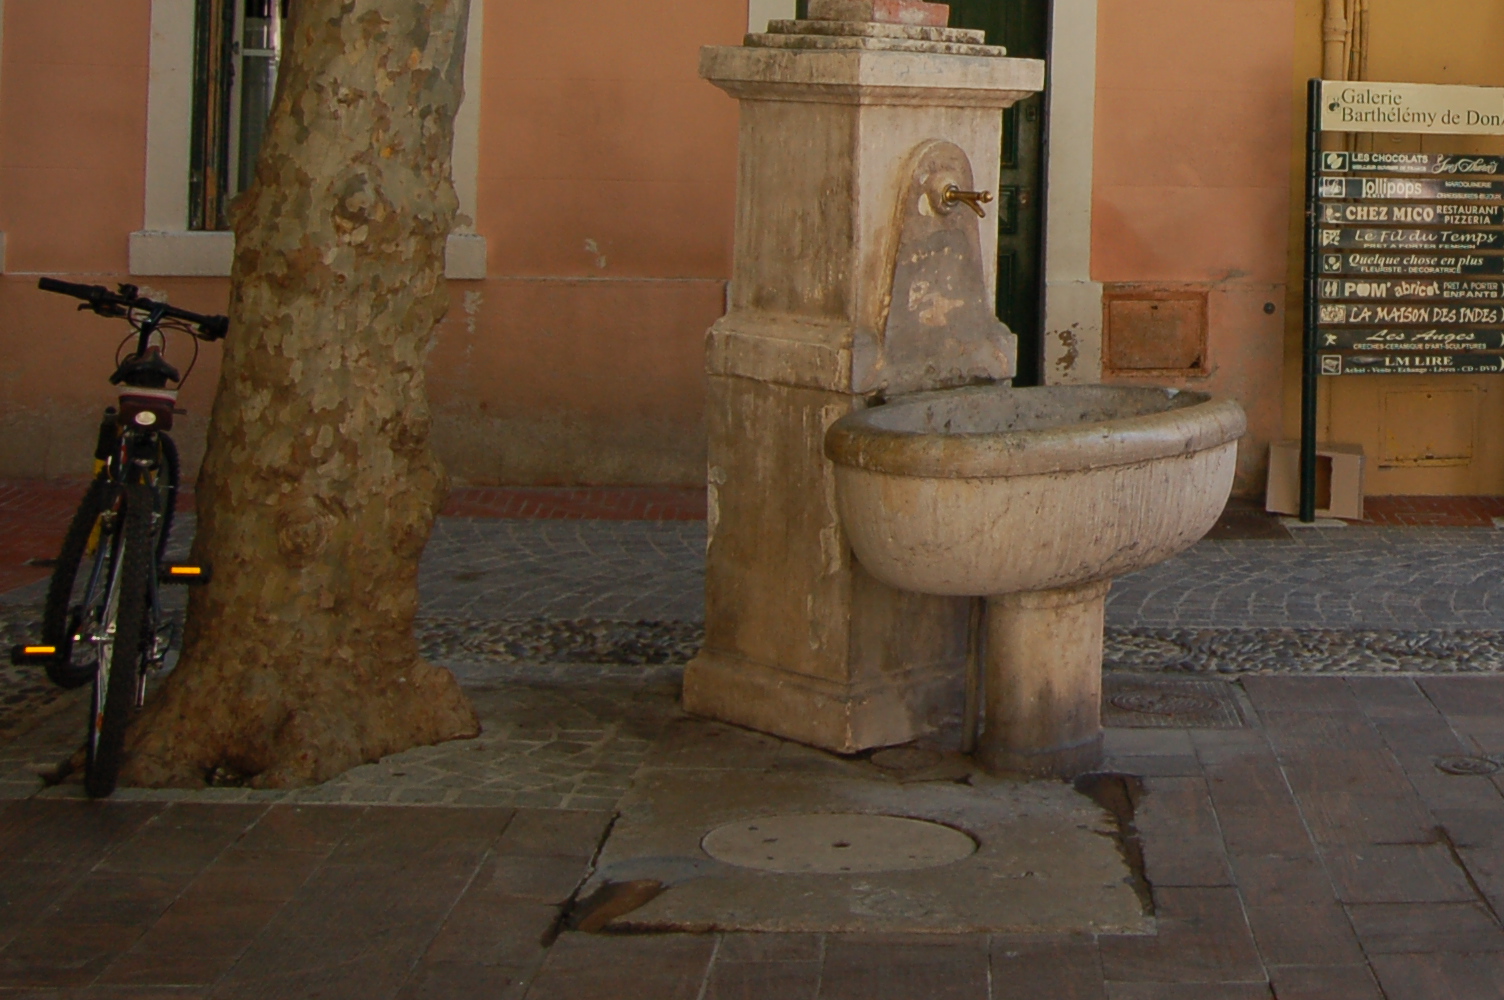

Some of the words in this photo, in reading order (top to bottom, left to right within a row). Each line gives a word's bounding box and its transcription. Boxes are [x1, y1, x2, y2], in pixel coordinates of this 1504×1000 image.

[1341, 87, 1403, 106] Galerie
[1342, 106, 1438, 128] Barthélémy
[1441, 109, 1460, 125] de
[1467, 109, 1500, 127] Don
[1352, 153, 1369, 163] LES
[1371, 154, 1429, 164] CHOCOLATS
[1345, 206, 1388, 221] CHEZ
[1393, 206, 1434, 222] MICO
[1436, 205, 1499, 215] RESTAURANT
[1444, 214, 1491, 224] PIZZERIA
[1355, 230, 1377, 242] Le
[1380, 230, 1406, 242] Fil
[1409, 230, 1438, 242] du
[1440, 230, 1498, 246] Temps
[1349, 253, 1401, 269] Quelque
[1403, 254, 1441, 266] chose
[1441, 257, 1456, 266] en
[1456, 255, 1484, 269] plus
[1394, 280, 1441, 298] abricot
[1443, 290, 1498, 298] ENFANTS
[1349, 306, 1373, 322] LA
[1375, 307, 1431, 323] MAISON
[1432, 307, 1457, 323] DES
[1459, 307, 1498, 323] INDES
[1366, 329, 1406, 341] Les
[1411, 329, 1476, 346] Anges
[1385, 356, 1410, 366] LM
[1414, 356, 1454, 366] LIRE
